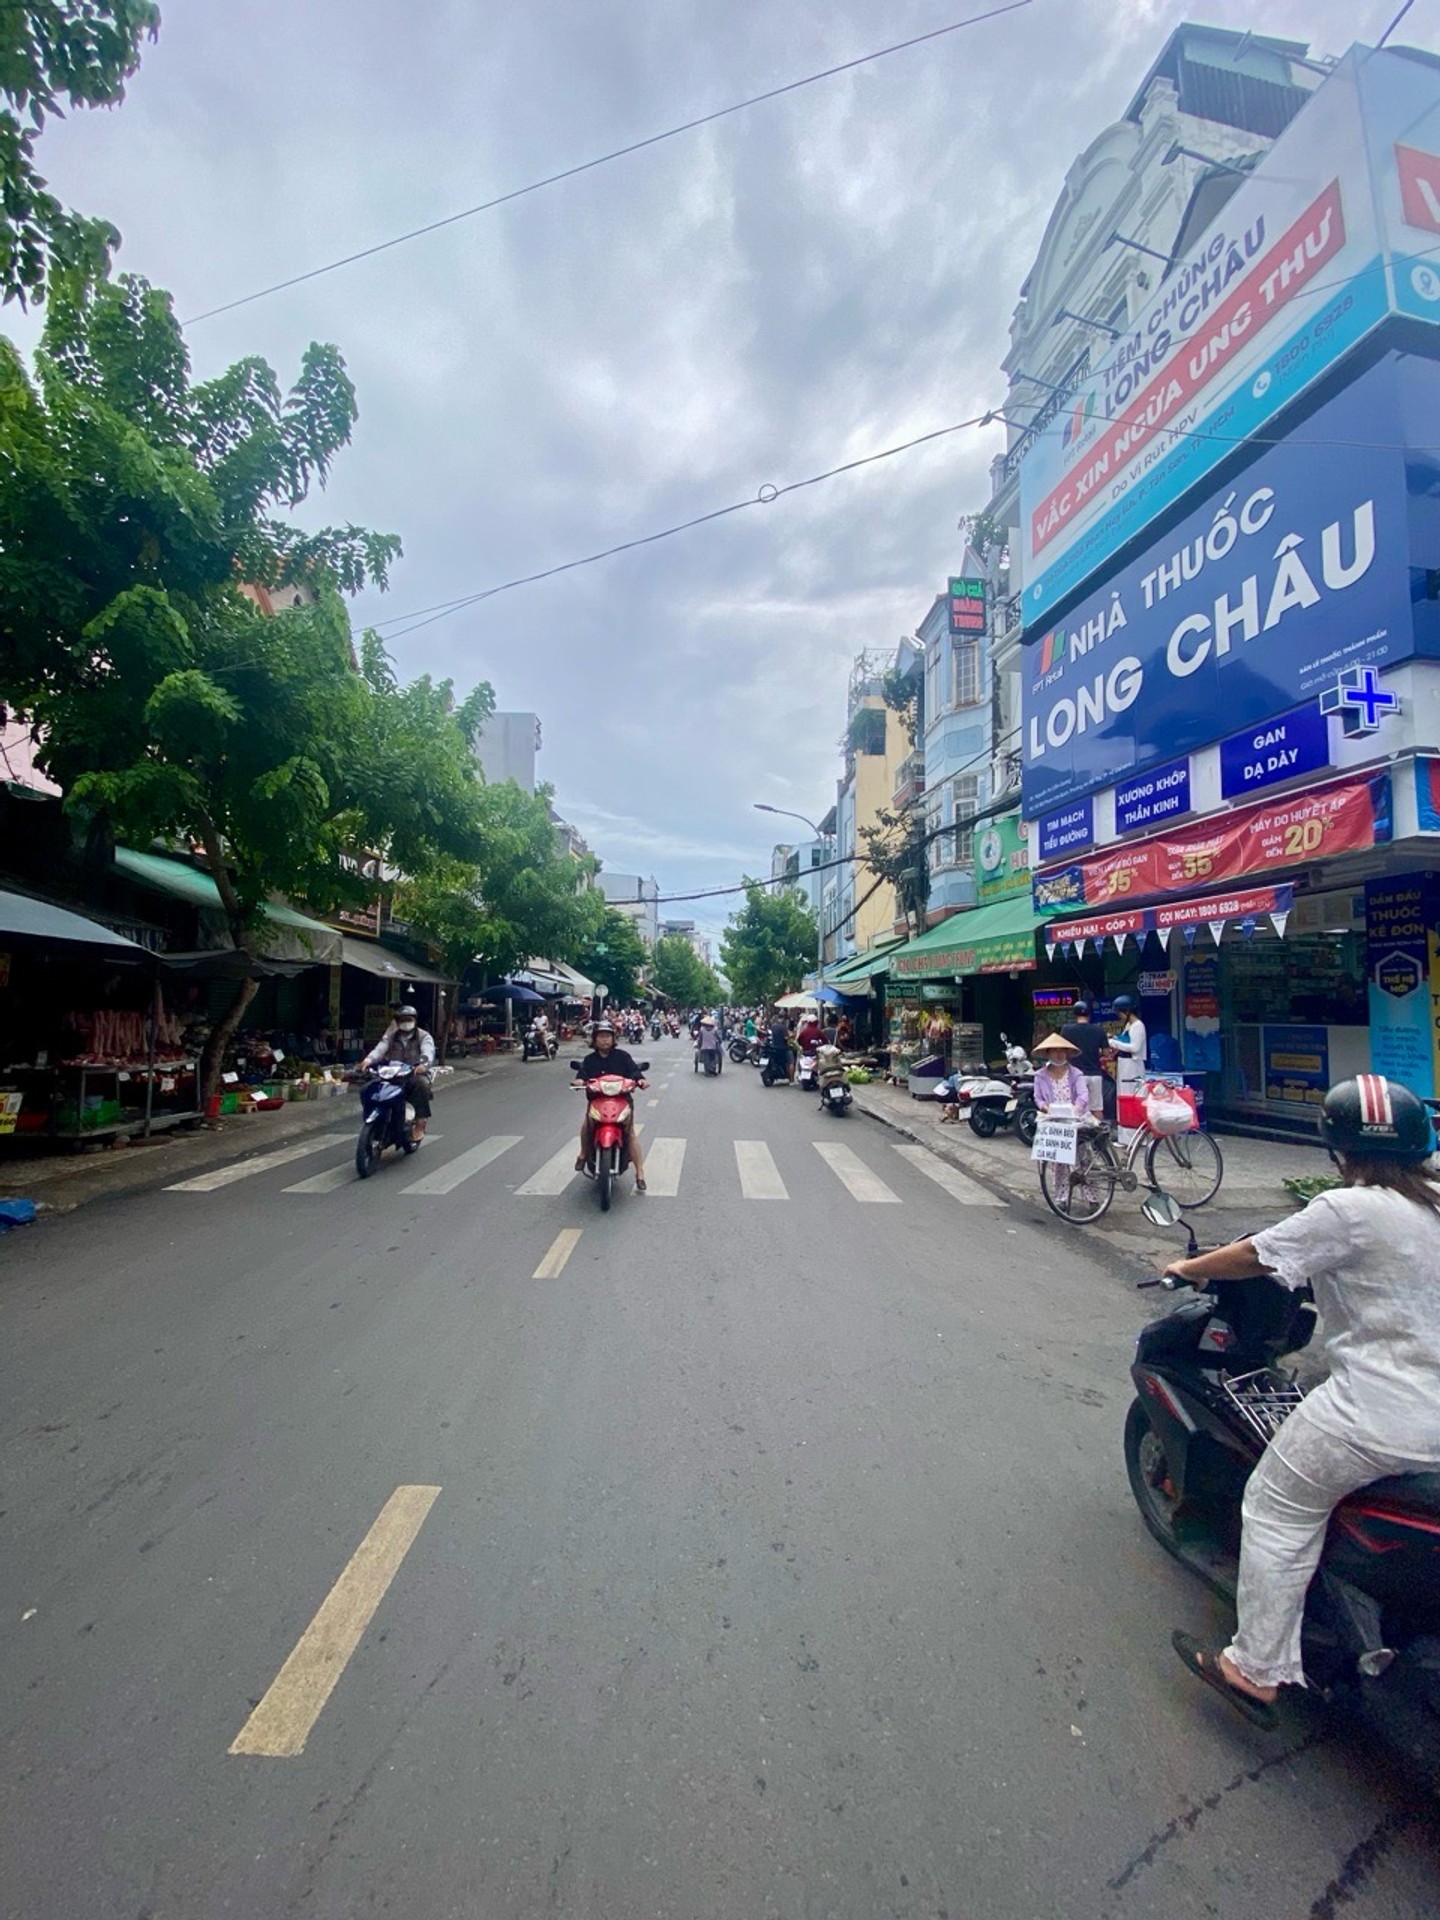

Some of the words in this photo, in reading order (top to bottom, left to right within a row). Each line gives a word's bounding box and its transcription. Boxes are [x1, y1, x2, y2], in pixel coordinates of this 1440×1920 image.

[1103, 331, 1142, 388] TIÊM
[1147, 232, 1226, 336] CHỦNG
[1104, 328, 1171, 420] LONG
[1178, 213, 1265, 332] CHÂU
[1273, 335, 1310, 375] 1800
[1313, 295, 1354, 338] 6928
[1036, 490, 1072, 540] VẮC
[1074, 452, 1109, 503] XIN
[1115, 378, 1183, 462] NGỪA
[1189, 301, 1253, 381] UNG
[1258, 205, 1333, 306] THƯ
[1111, 479, 1128, 501] Do
[1168, 406, 1199, 445] HPV
[1069, 590, 1128, 664] NHÀ
[1140, 487, 1275, 610] THUỐC
[1030, 656, 1144, 761] LONG
[1166, 499, 1376, 679] CHÂU
[1253, 726, 1286, 750] GAN
[1244, 763, 1265, 780] DẠ
[1267, 749, 1299, 772] DÀY
[1118, 783, 1154, 807] XƯƠNG
[1156, 770, 1187, 792] KHỚP
[1046, 821, 1059, 833] TIM
[1060, 809, 1085, 829] MẠCH
[1125, 805, 1151, 825] THẦN
[1153, 795, 1180, 815] KINH
[1251, 818, 1271, 834] MÁY
[1273, 813, 1290, 828] ĐO
[1291, 802, 1327, 824] HUYẾT
[1329, 796, 1347, 813] ÁP
[1044, 834, 1059, 851] TIỂU
[1059, 827, 1089, 847] ĐƯỜNG
[1056, 923, 1082, 939] KHIẾU
[1083, 924, 1099, 937] NẠI
[1105, 918, 1127, 932] GÓP
[1128, 916, 1136, 928] Ý
[1159, 911, 1173, 925] GỌI
[1174, 908, 1198, 921] NGAY:
[1198, 904, 1218, 918] 1800
[1218, 900, 1239, 914] 6928
[1371, 906, 1422, 922] THUỐC
[1369, 924, 1387, 938] KÊ
[1391, 922, 1425, 936] ĐƠN
